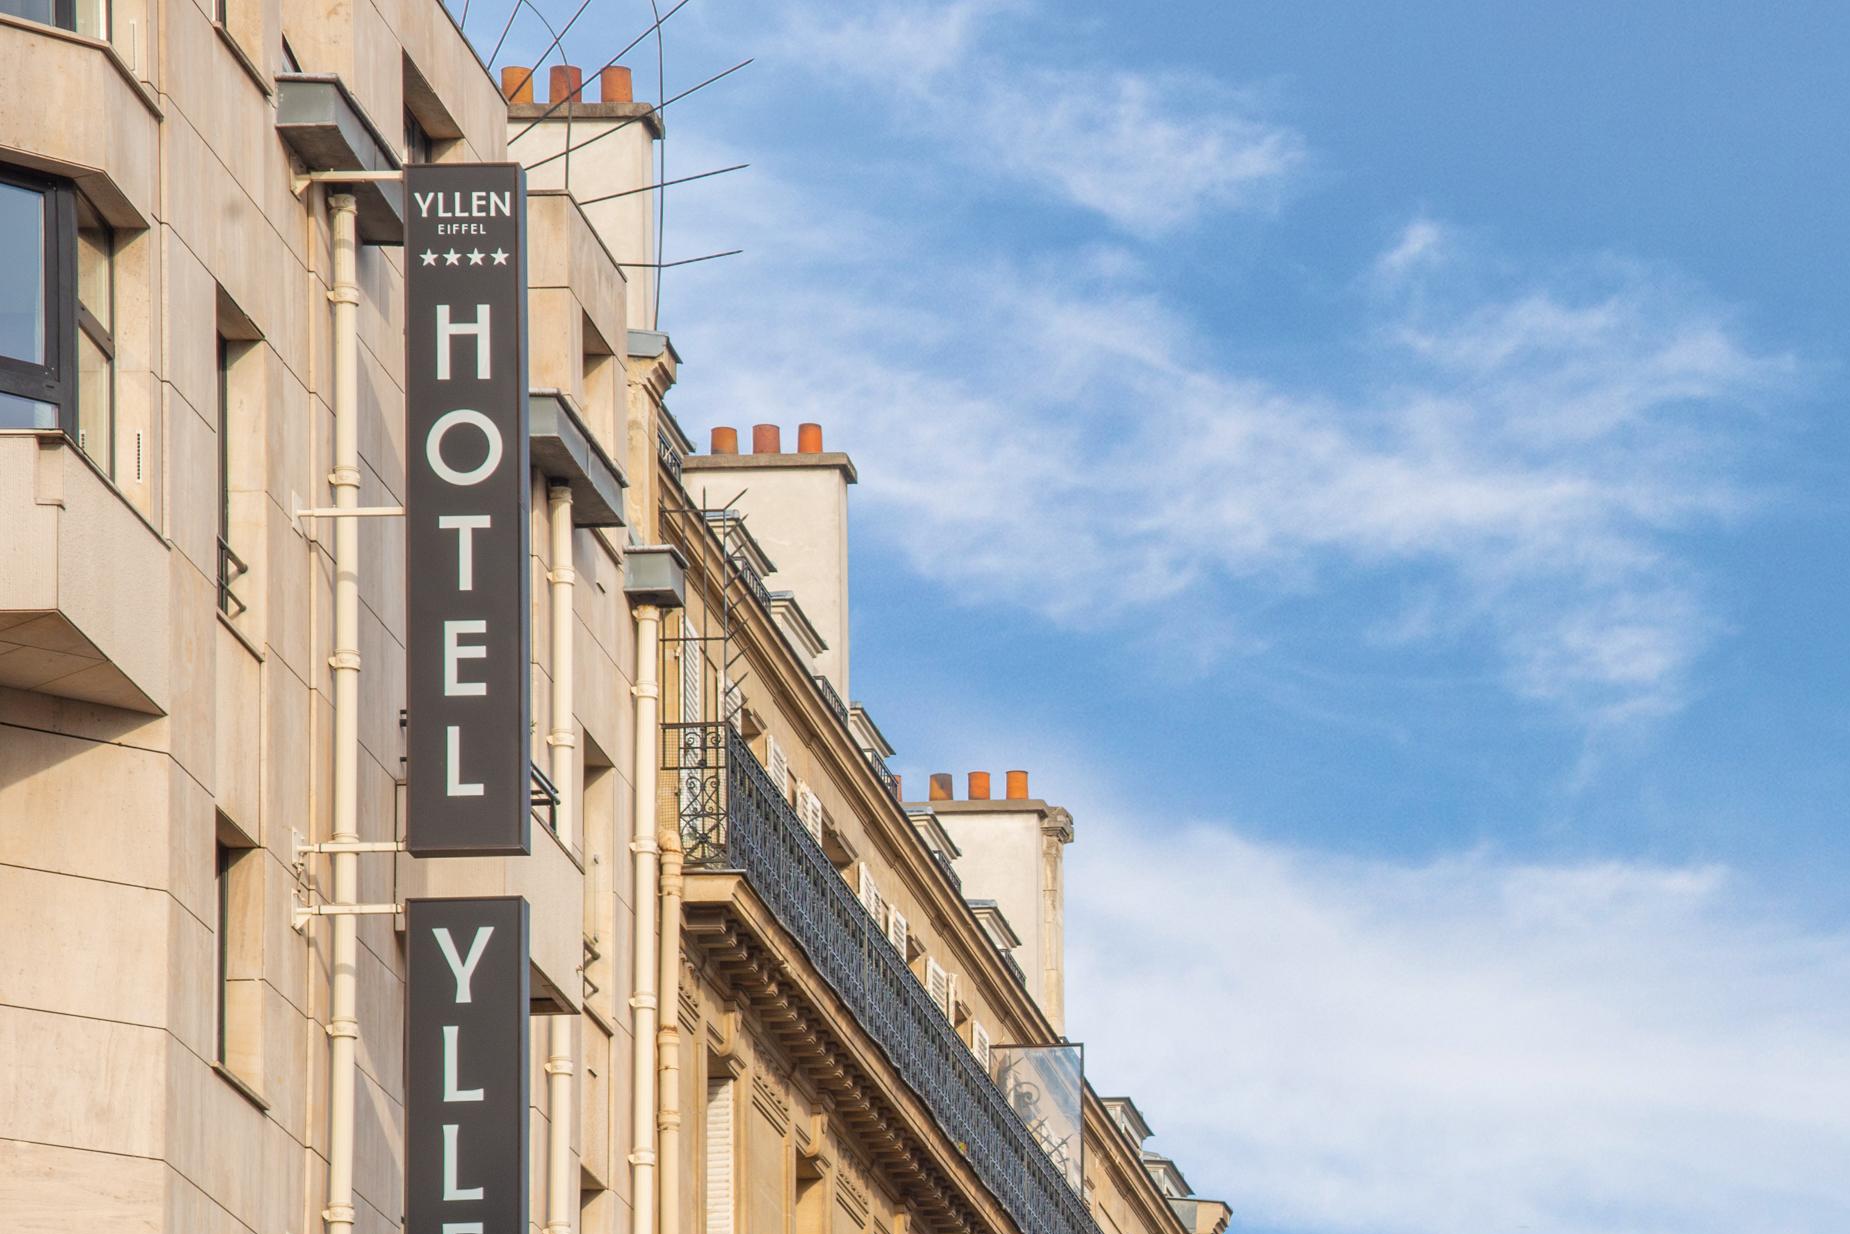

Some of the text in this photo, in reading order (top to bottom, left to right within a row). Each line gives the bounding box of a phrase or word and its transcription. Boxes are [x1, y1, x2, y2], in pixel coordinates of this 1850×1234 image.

[413, 191, 512, 218] YLLEN
[437, 223, 487, 235] EIFFEL
[426, 303, 503, 797] HOTEL
